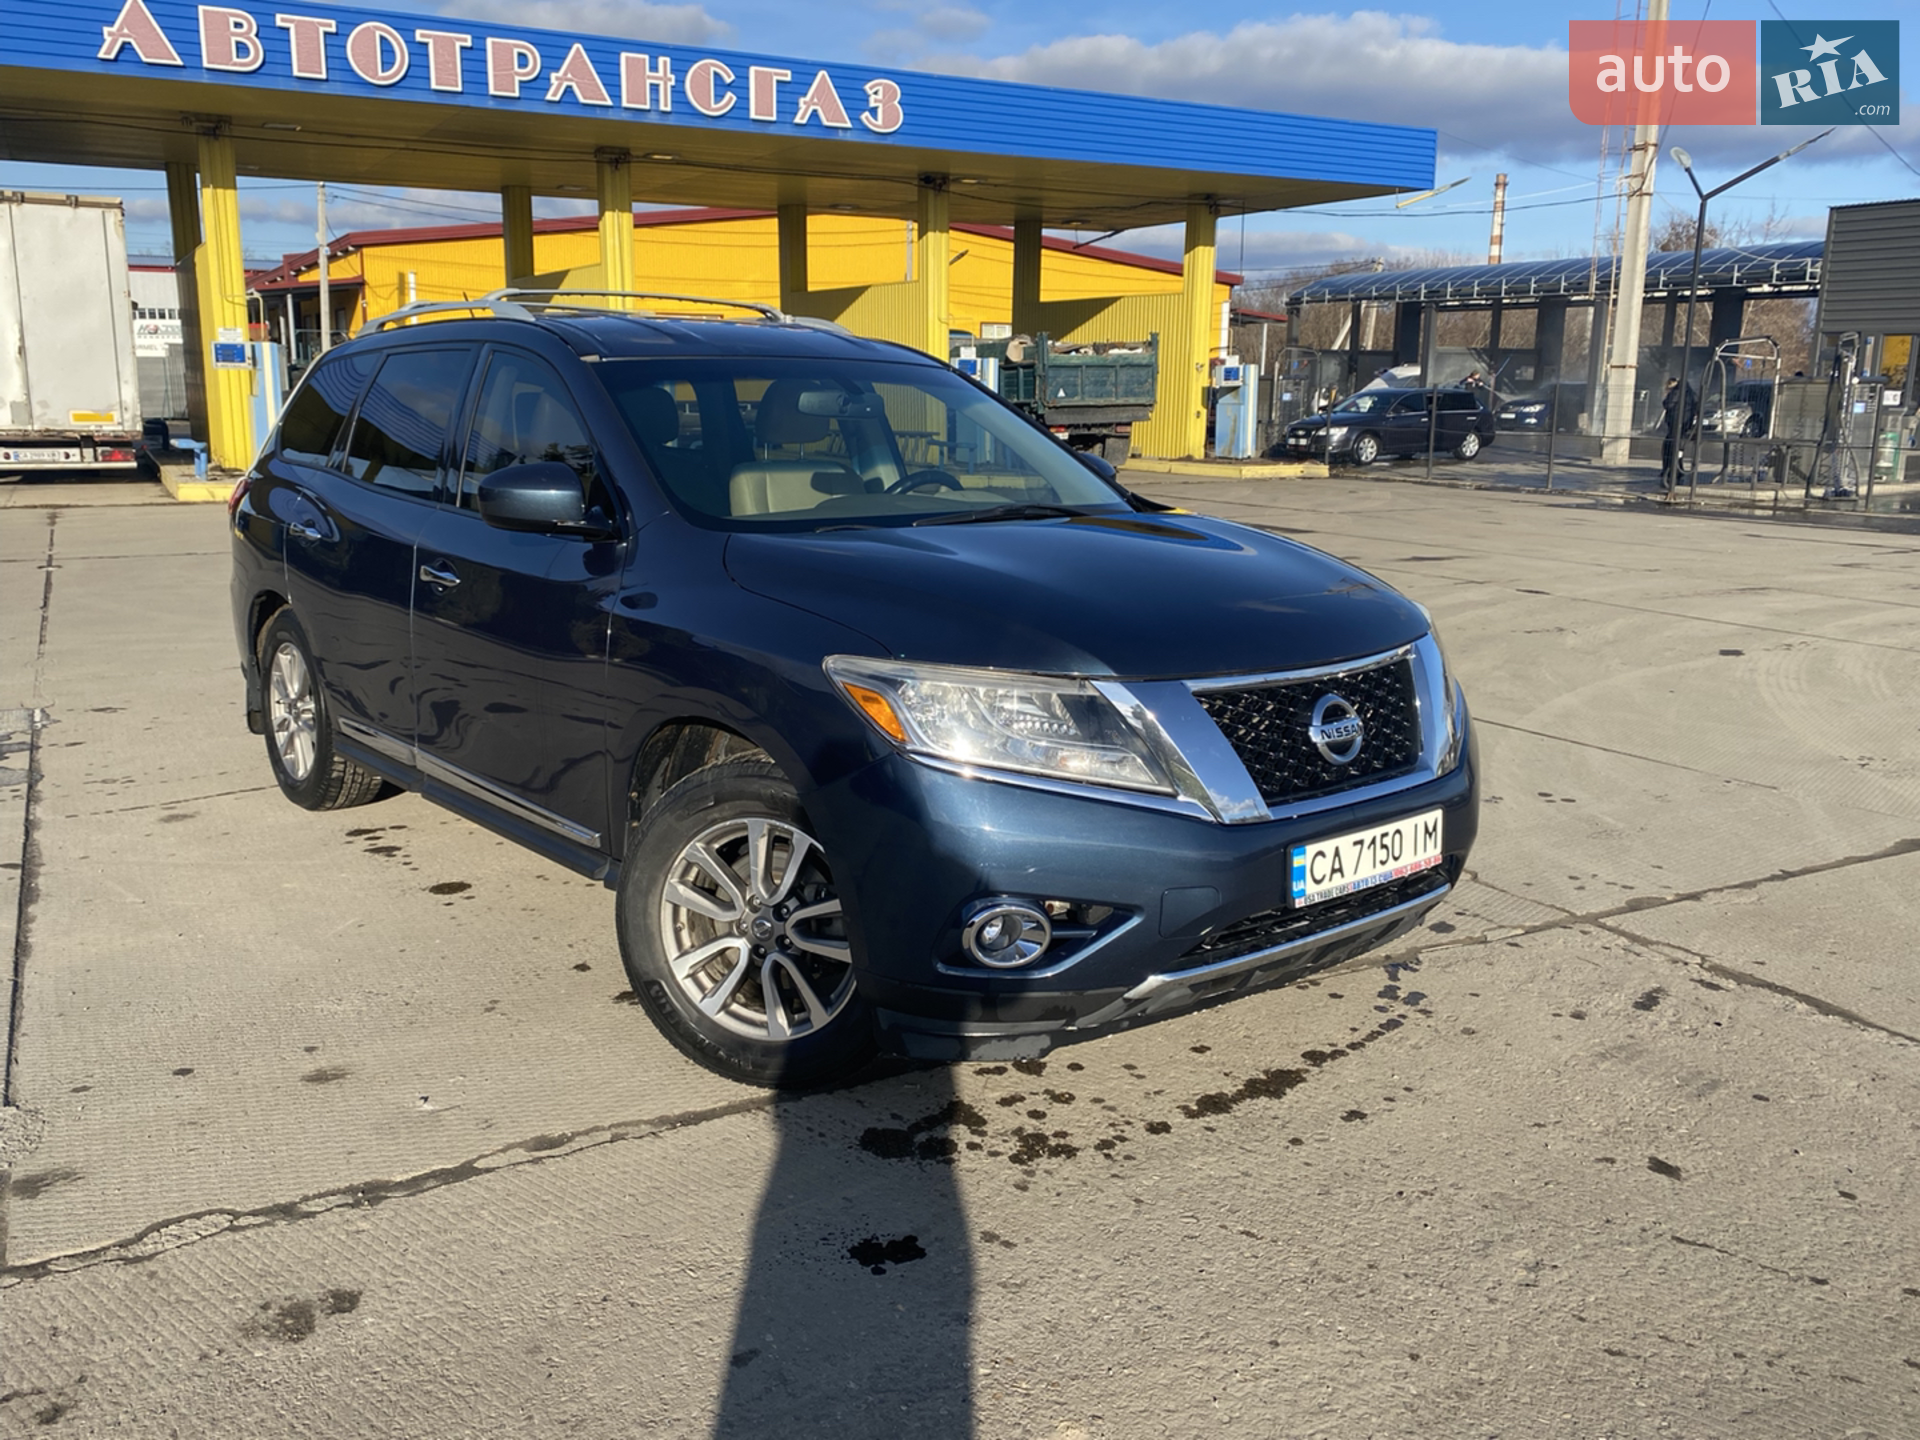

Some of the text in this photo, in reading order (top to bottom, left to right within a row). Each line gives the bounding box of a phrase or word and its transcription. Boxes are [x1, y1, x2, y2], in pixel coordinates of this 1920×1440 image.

[97, 0, 904, 135] АВТОТРАНСГАЗ
[1320, 723, 1363, 739] NISSAN
[1310, 845, 1345, 885] CA
[1352, 828, 1403, 876] 7150
[1414, 816, 1438, 857] IM
[1293, 880, 1305, 892] UA
